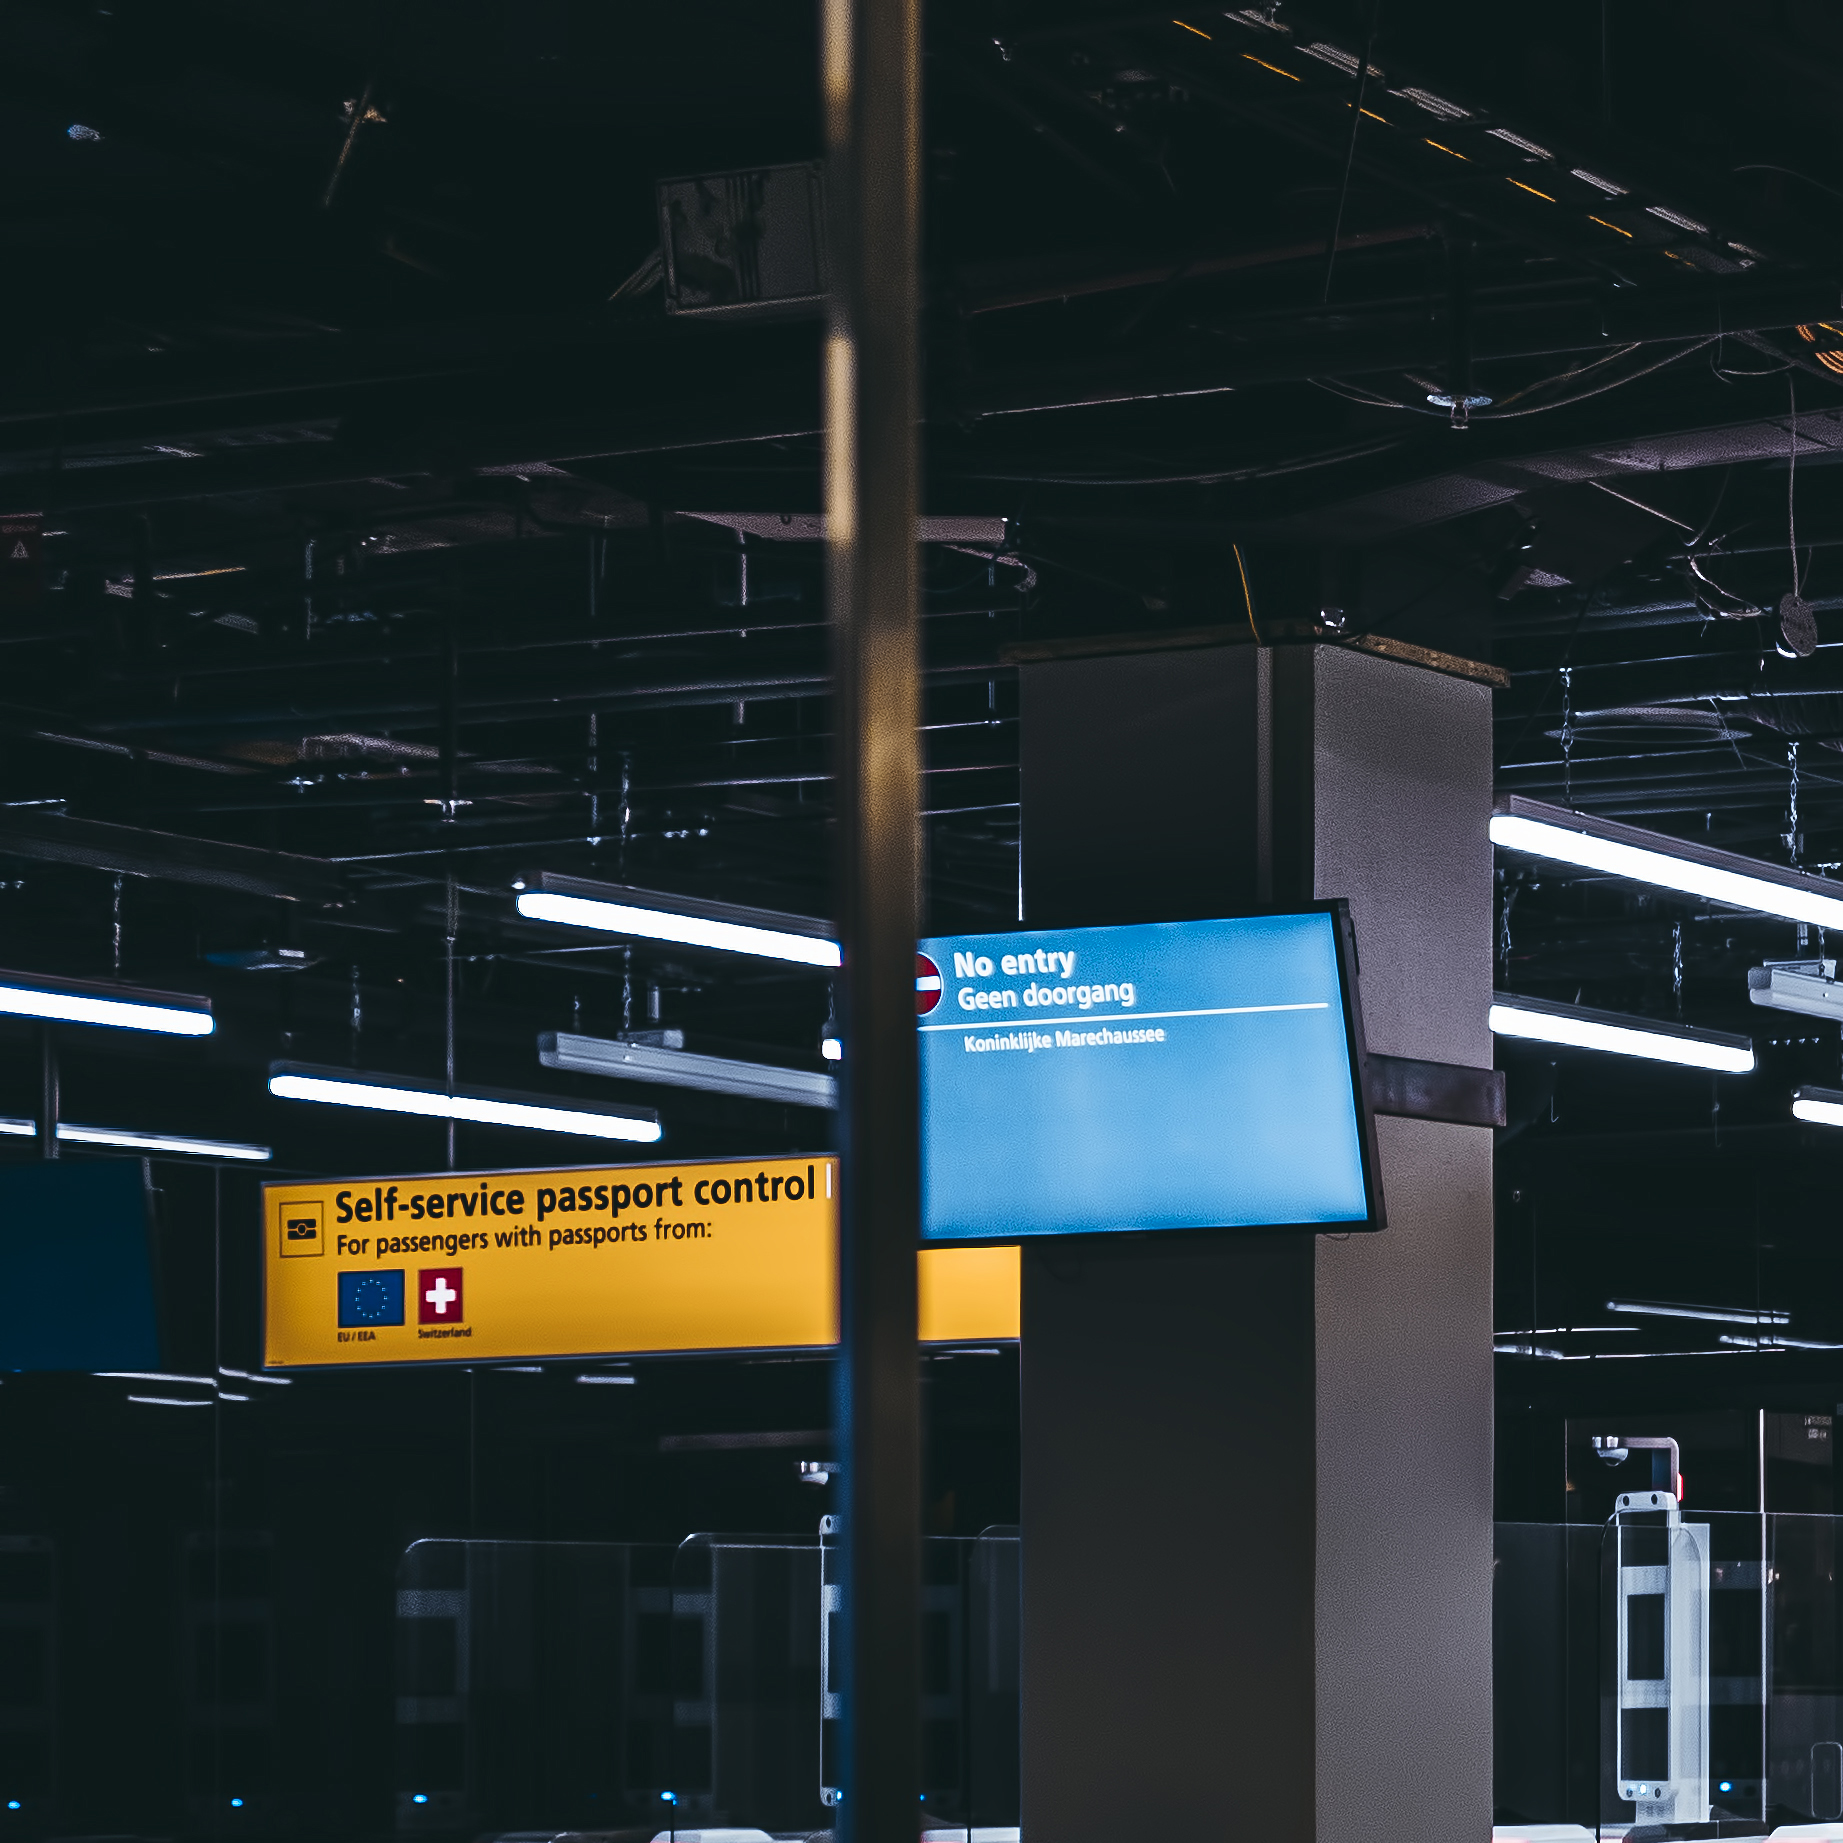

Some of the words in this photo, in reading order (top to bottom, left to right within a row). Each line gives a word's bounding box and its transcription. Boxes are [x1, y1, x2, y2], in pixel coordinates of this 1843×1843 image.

[953, 951, 993, 978] No
[1001, 949, 1075, 978] entry
[958, 986, 1017, 1011] Geen
[1022, 982, 1135, 1009] doorgang
[964, 1032, 1052, 1053] Koninklijke
[1055, 1027, 1165, 1048] Marechaussee
[335, 1183, 525, 1224] Self-service
[537, 1176, 683, 1222] passport
[694, 1165, 815, 1205] control
[337, 1234, 370, 1255] For
[376, 1230, 488, 1259] passengers
[495, 1224, 541, 1249] with
[549, 1222, 647, 1250] passports
[654, 1218, 712, 1240] from:
